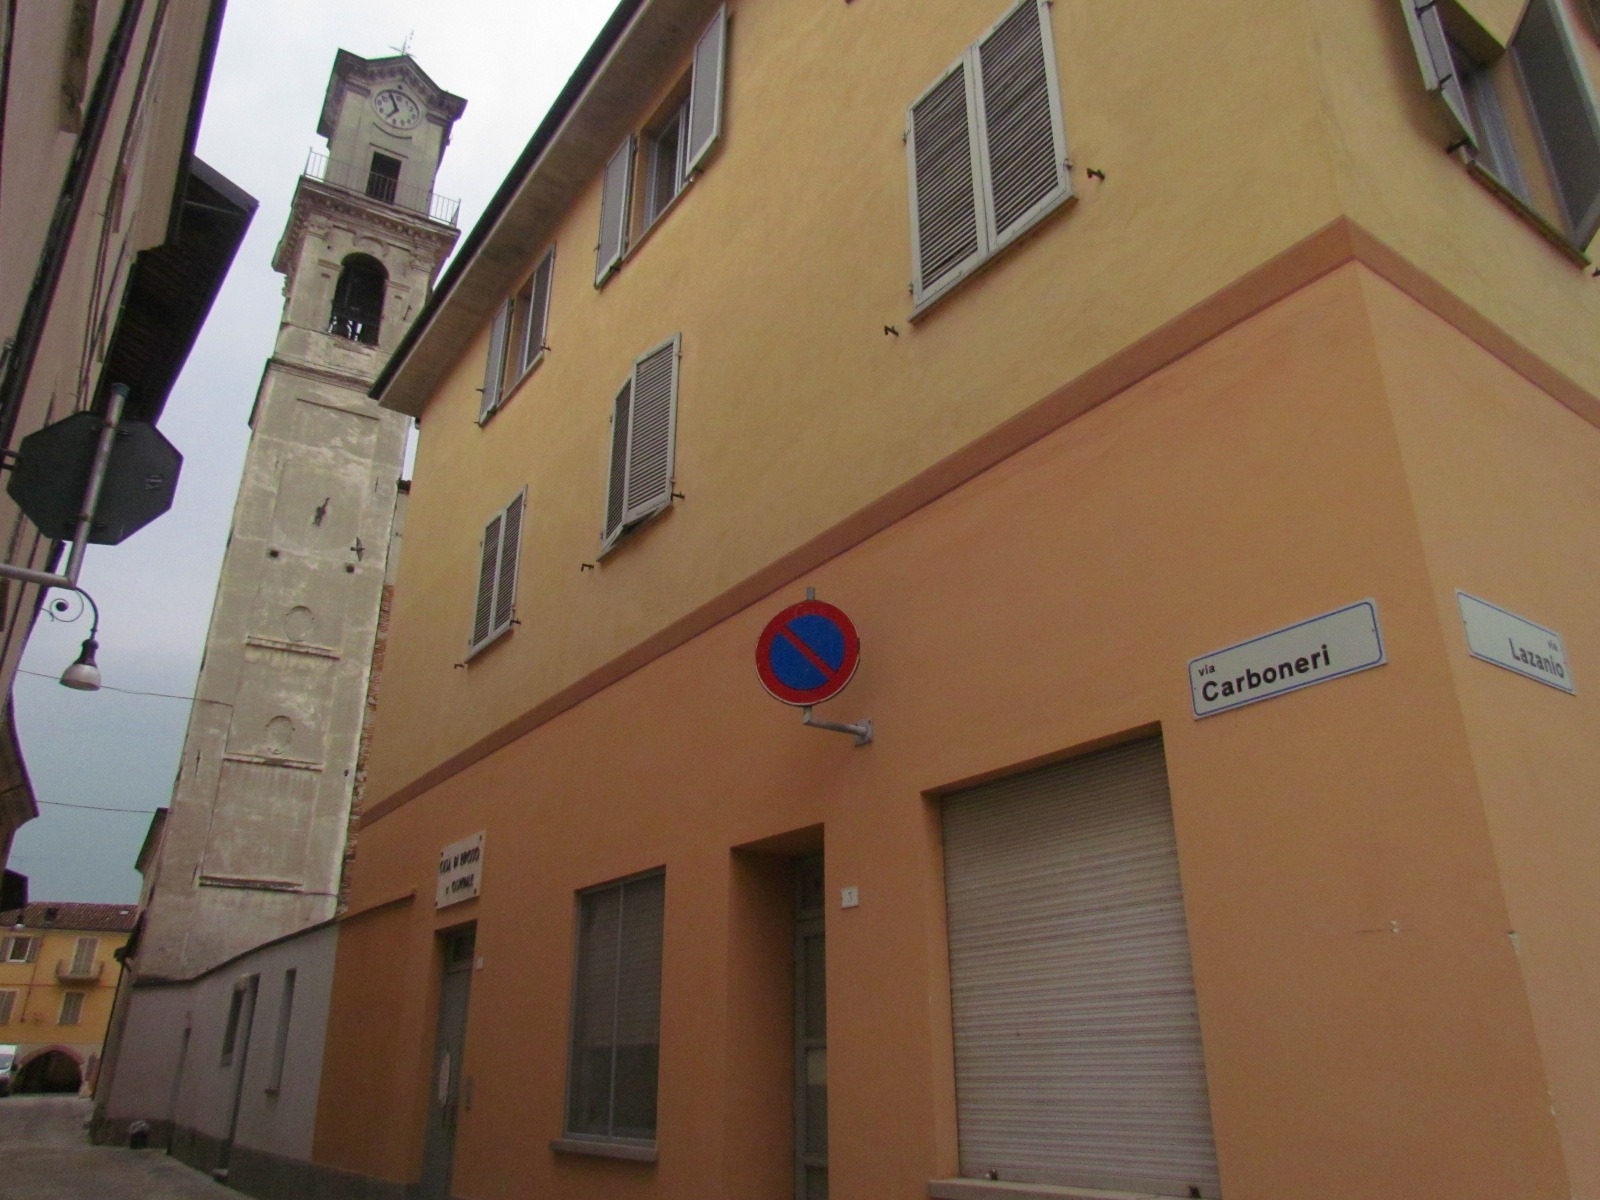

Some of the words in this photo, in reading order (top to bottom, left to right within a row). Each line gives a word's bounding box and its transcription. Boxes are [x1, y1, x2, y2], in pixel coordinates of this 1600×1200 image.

[1198, 664, 1215, 676] via
[1202, 644, 1330, 701] Carboneri
[1508, 637, 1564, 678] Lazanio
